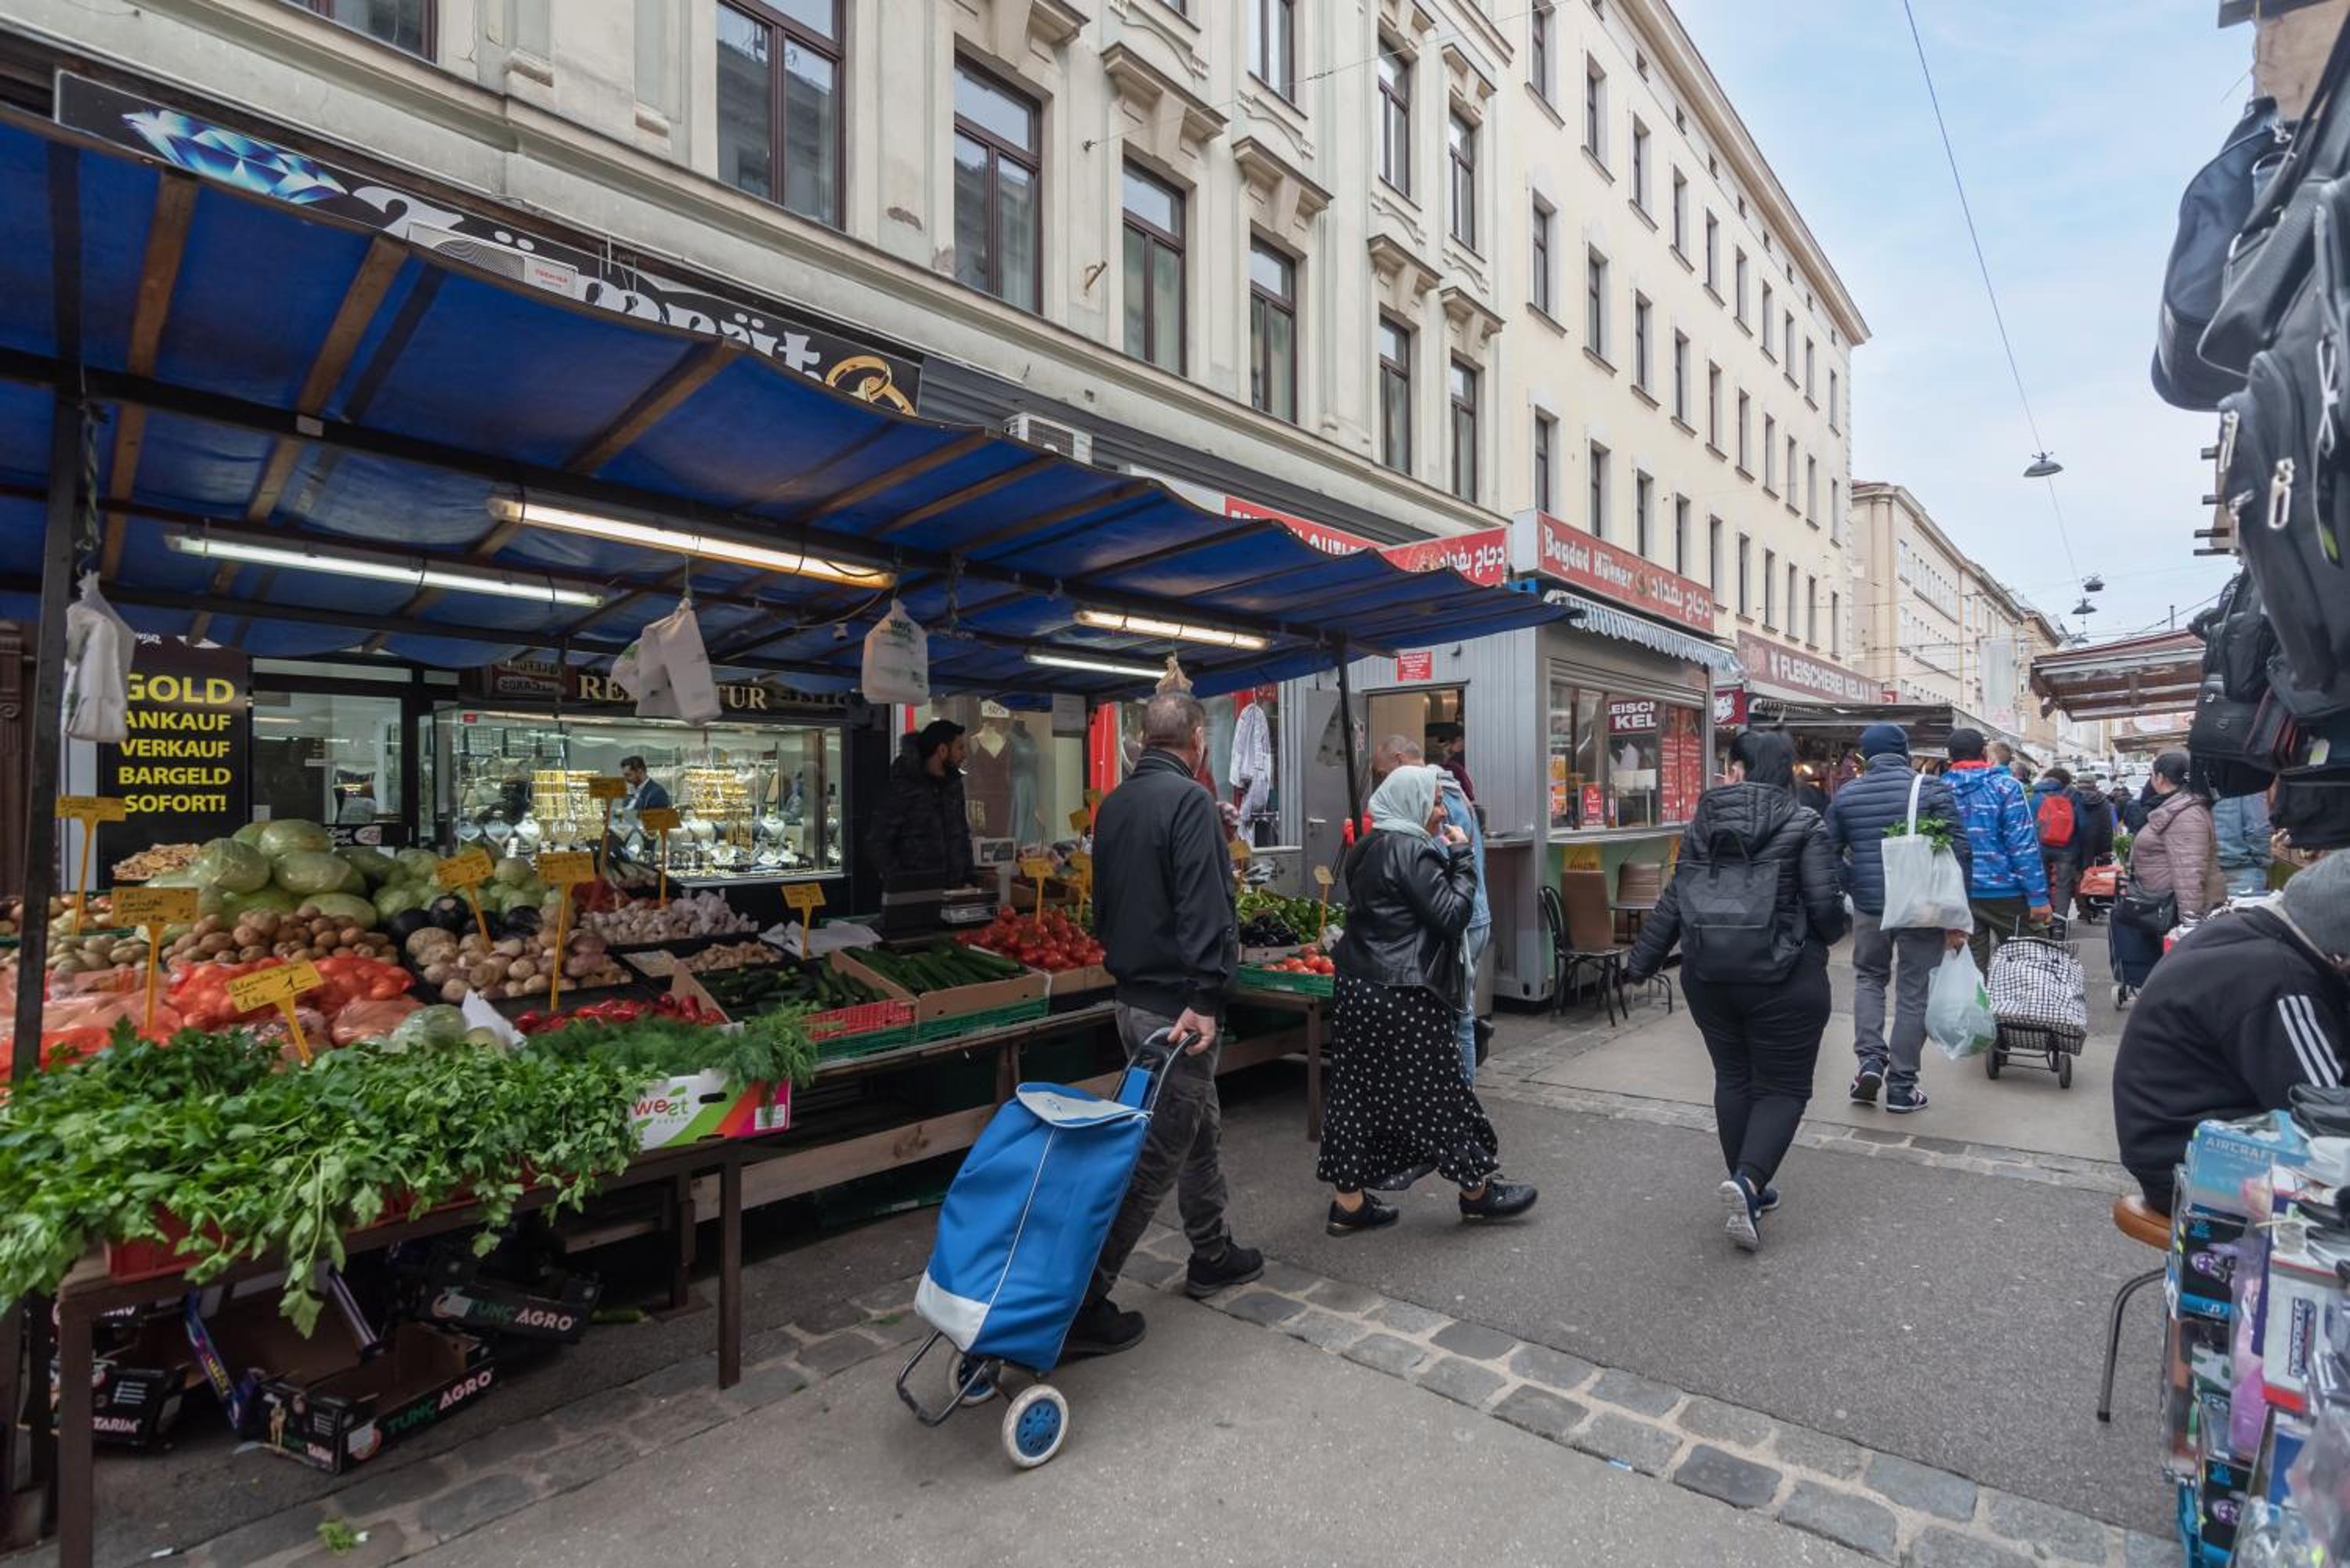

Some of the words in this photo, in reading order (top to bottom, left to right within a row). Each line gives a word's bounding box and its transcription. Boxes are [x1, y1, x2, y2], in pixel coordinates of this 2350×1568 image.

[1544, 526, 1589, 573] Bagdad
[1594, 551, 1632, 589] Hühner
[1652, 576, 1683, 614] بغداد
[1686, 591, 1710, 623] دجاج
[125, 674, 235, 704] GOLD
[1780, 655, 1843, 695] FLEISCHEREI
[125, 710, 231, 731] ANKAUF
[119, 740, 230, 757] VERKAUF
[118, 767, 232, 786] BARGELD
[125, 794, 227, 813] SOFORT!
[515, 1307, 574, 1331] AGRO
[387, 1401, 436, 1435] TUNÇ
[437, 1368, 494, 1411] AGRO
